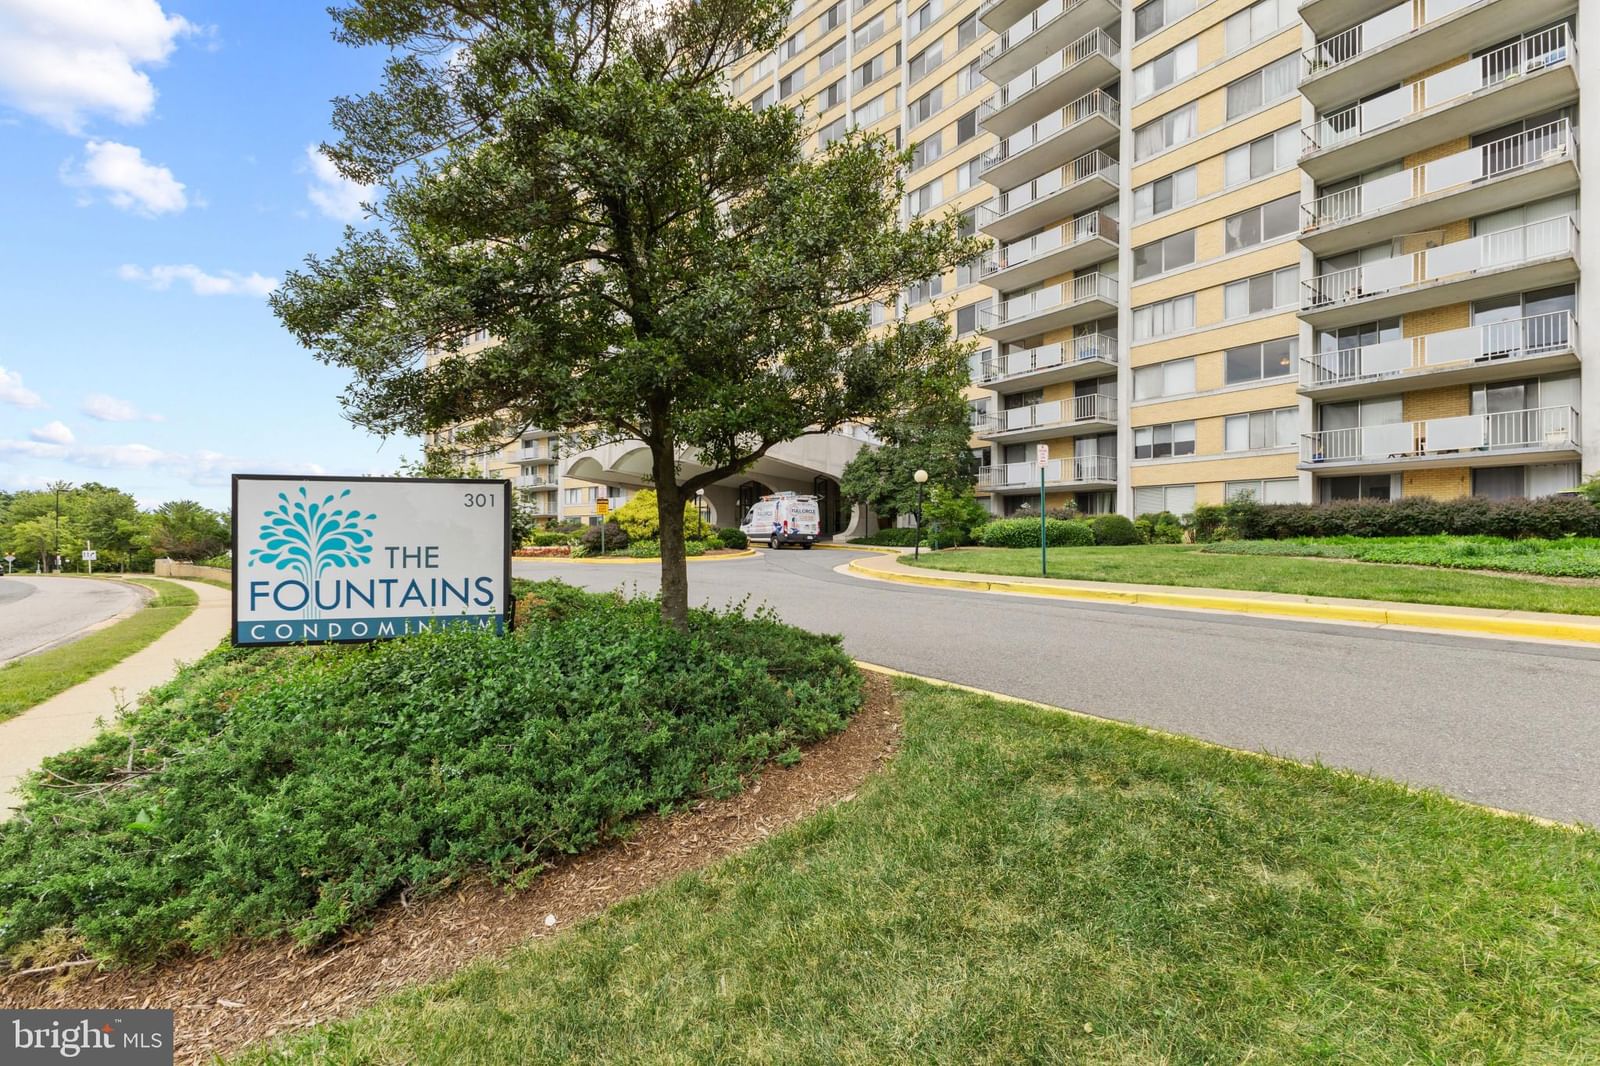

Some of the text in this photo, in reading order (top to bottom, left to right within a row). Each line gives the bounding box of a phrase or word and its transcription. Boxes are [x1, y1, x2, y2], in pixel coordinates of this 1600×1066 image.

[463, 493, 496, 508] 301
[384, 546, 440, 569] THE
[249, 576, 495, 612] FOUNTAINS
